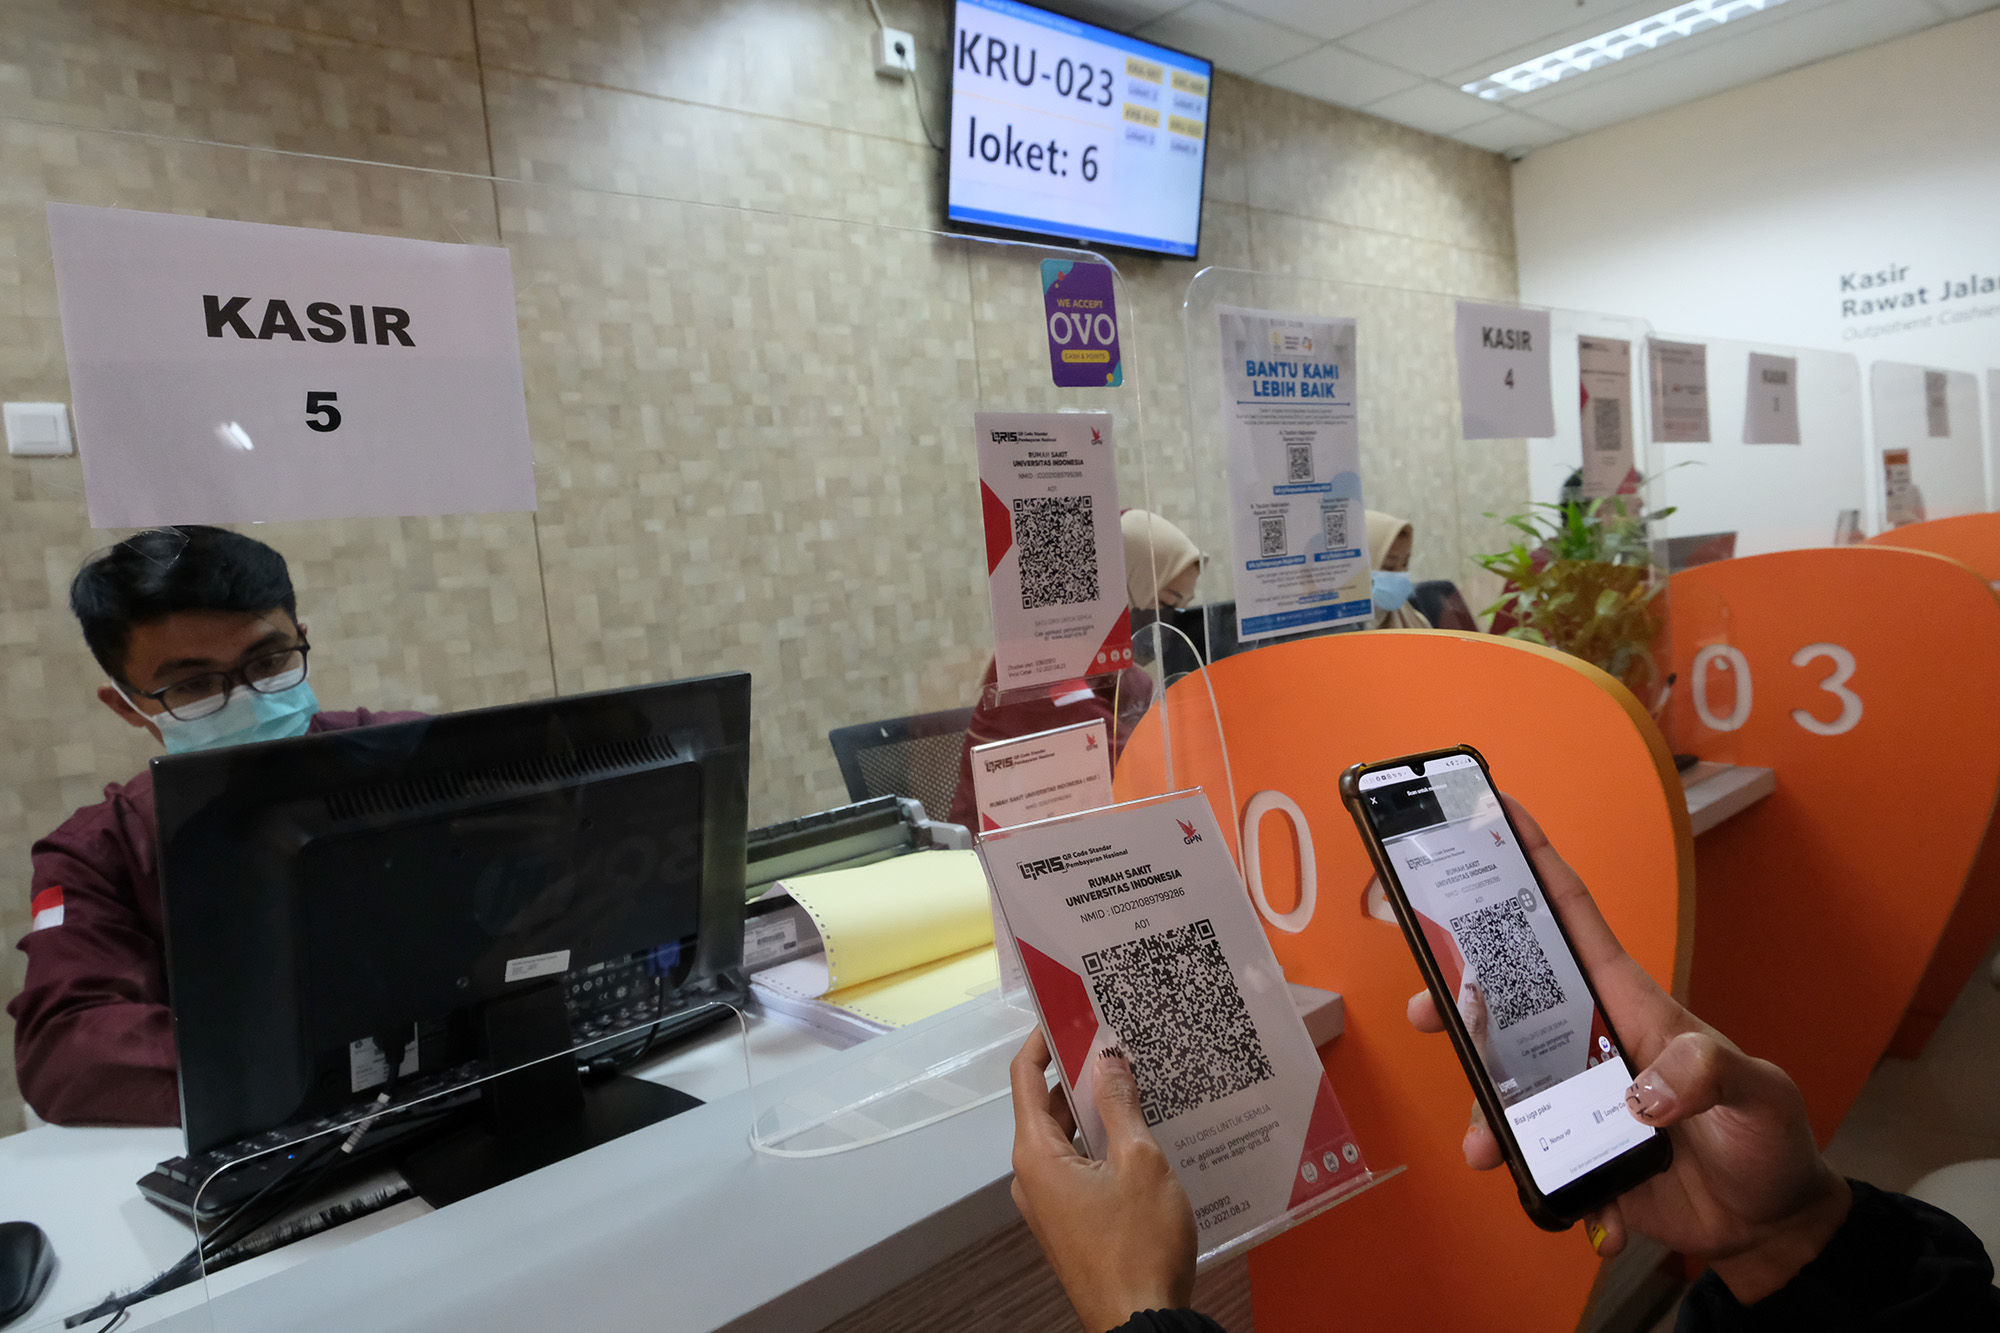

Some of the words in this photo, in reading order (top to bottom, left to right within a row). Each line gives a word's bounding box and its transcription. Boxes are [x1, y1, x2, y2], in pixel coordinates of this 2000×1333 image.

[957, 28, 1114, 108] KRU-023
[968, 115, 1069, 178] loket:
[1081, 144, 1099, 183] 6
[1840, 263, 1910, 293] Kasir
[1056, 298, 1071, 309] WE
[1072, 299, 1103, 309] ACCEPT
[1841, 287, 1929, 318] Rawat
[1939, 274, 2000, 302] Jala
[202, 294, 416, 347] KASIR
[1050, 311, 1116, 346] OVO
[1481, 326, 1533, 352] KASIR
[1245, 359, 1298, 379] BANTU
[1302, 362, 1340, 380] KAMI
[1503, 368, 1515, 390] 4
[1252, 380, 1296, 398] LEBIH
[1300, 381, 1336, 399] BAIK
[304, 390, 342, 433] 5
[991, 431, 1018, 445] QRIS
[1012, 459, 1052, 467] UNIVERSITAS
[1691, 641, 1864, 736] 03
[985, 756, 1014, 774] QRIS
[1183, 833, 1203, 846] GPN
[1062, 852, 1072, 861] QR
[1072, 848, 1089, 859] Code
[1065, 854, 1103, 869] Pembayaran
[1103, 848, 1129, 860] Nasional
[1018, 855, 1066, 881] QRIS
[1087, 870, 1125, 889] RUMAH
[1124, 863, 1153, 880] SAKIT
[1469, 863, 1497, 878] INDONESIA
[1065, 880, 1131, 908] UNIVERSITAS
[1130, 868, 1183, 891] INDONESIA
[1079, 908, 1106, 924] NMID
[1111, 886, 1186, 916] ID2021089799286
[1134, 918, 1151, 931] A01
[1513, 1115, 1526, 1125] Bisa
[1526, 1110, 1538, 1122] juga
[1537, 1101, 1552, 1116] pakai
[1173, 1136, 1197, 1152] SATU
[1197, 1126, 1217, 1146] QRIS
[1217, 1115, 1244, 1134] UNTUK
[1243, 1102, 1272, 1123] SEMUA
[1179, 1155, 1197, 1169] Cek
[1198, 1142, 1227, 1162] aplikasi
[1227, 1119, 1280, 1150] penyelenggara
[1194, 1194, 1232, 1219] 93600912
